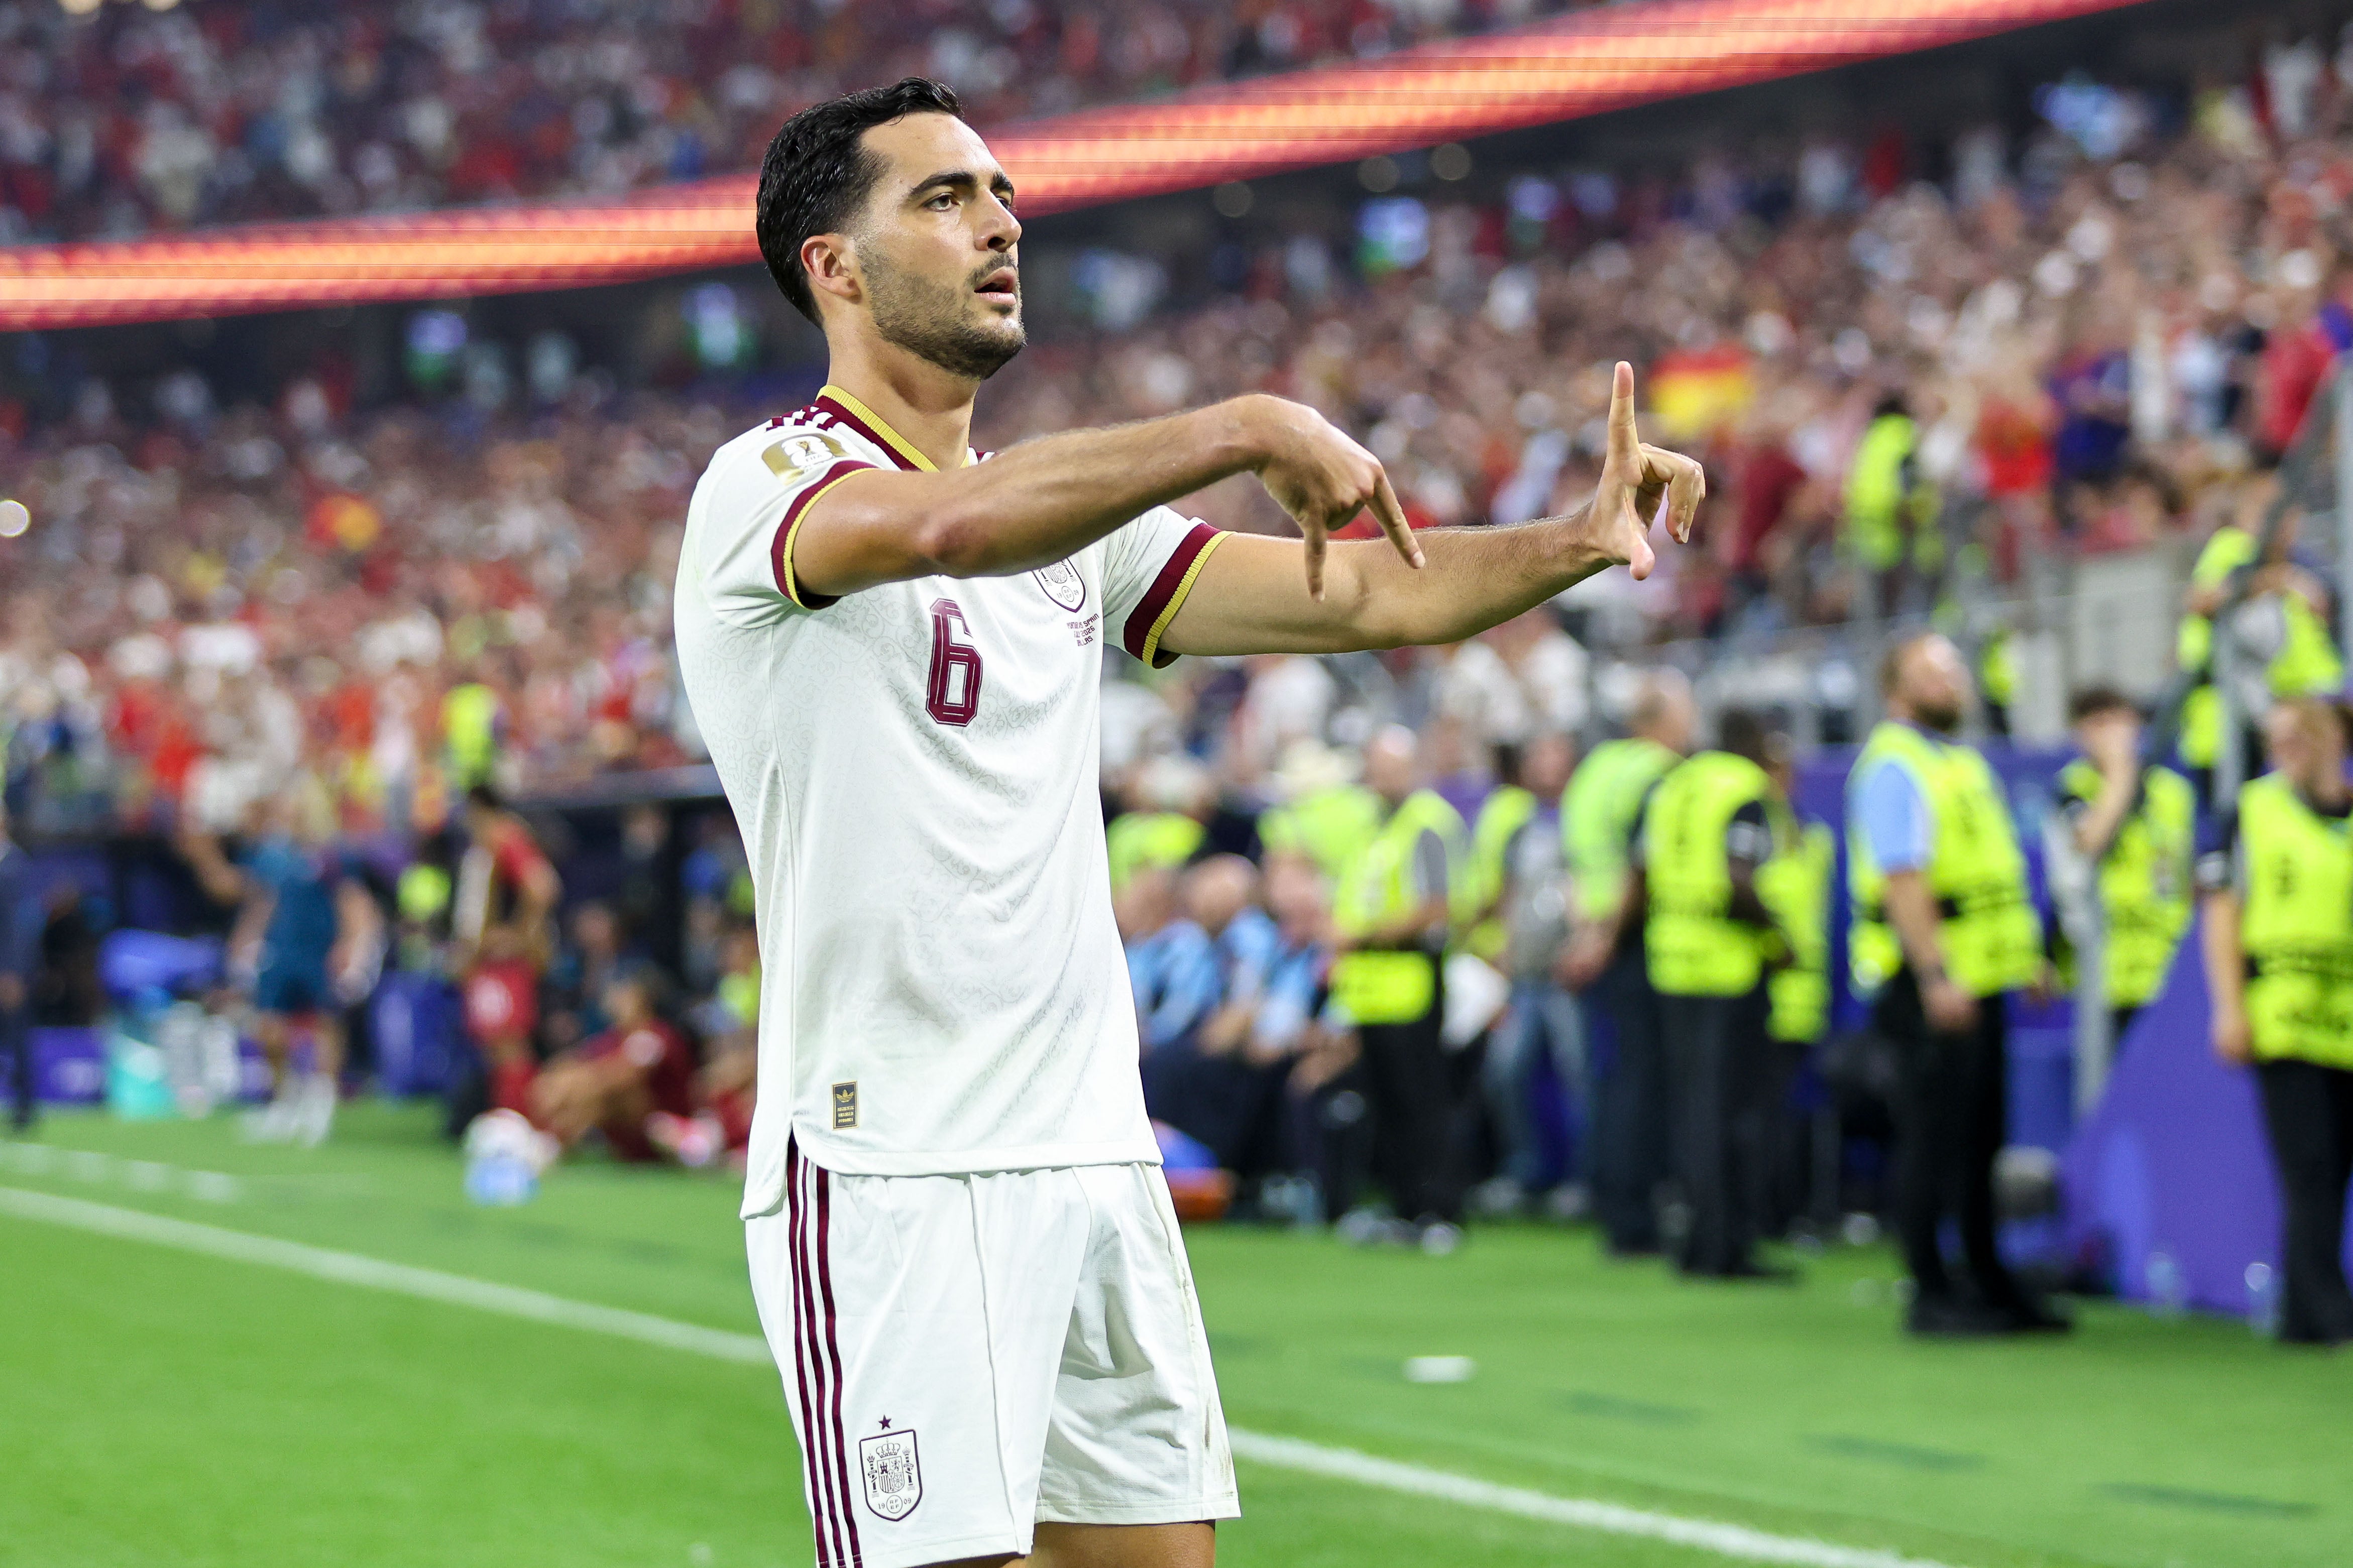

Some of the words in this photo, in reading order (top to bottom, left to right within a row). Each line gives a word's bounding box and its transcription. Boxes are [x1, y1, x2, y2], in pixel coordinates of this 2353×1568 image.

[1083, 613, 1100, 627] SPAIN
[1080, 625, 1095, 637] 2026
[925, 598, 983, 727] 6
